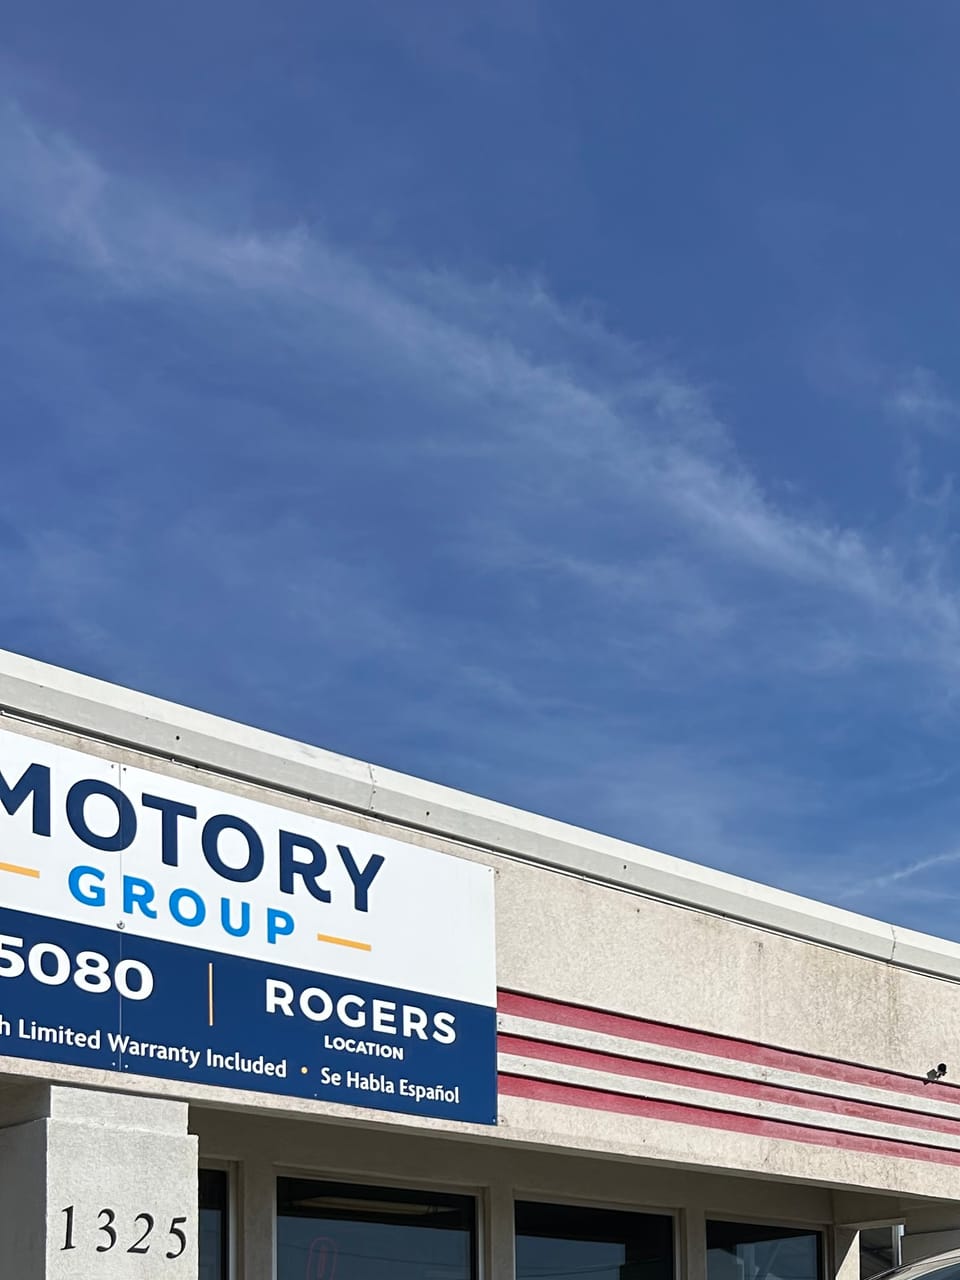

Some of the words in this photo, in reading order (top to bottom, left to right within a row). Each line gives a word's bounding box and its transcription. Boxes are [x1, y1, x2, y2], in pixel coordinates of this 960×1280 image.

[0, 762, 385, 913] MOTORY
[67, 864, 295, 945] GROUP
[0, 934, 155, 1001] 5080
[265, 978, 457, 1044] ROGERS
[18, 1018, 101, 1050] Limited
[107, 1032, 200, 1069] Warranty
[206, 1048, 287, 1079] Included
[323, 1034, 404, 1061] LOCATION
[321, 1066, 342, 1086] Se
[346, 1070, 395, 1094] Habla
[399, 1078, 460, 1104] Español
[60, 1205, 188, 1259] 1325
